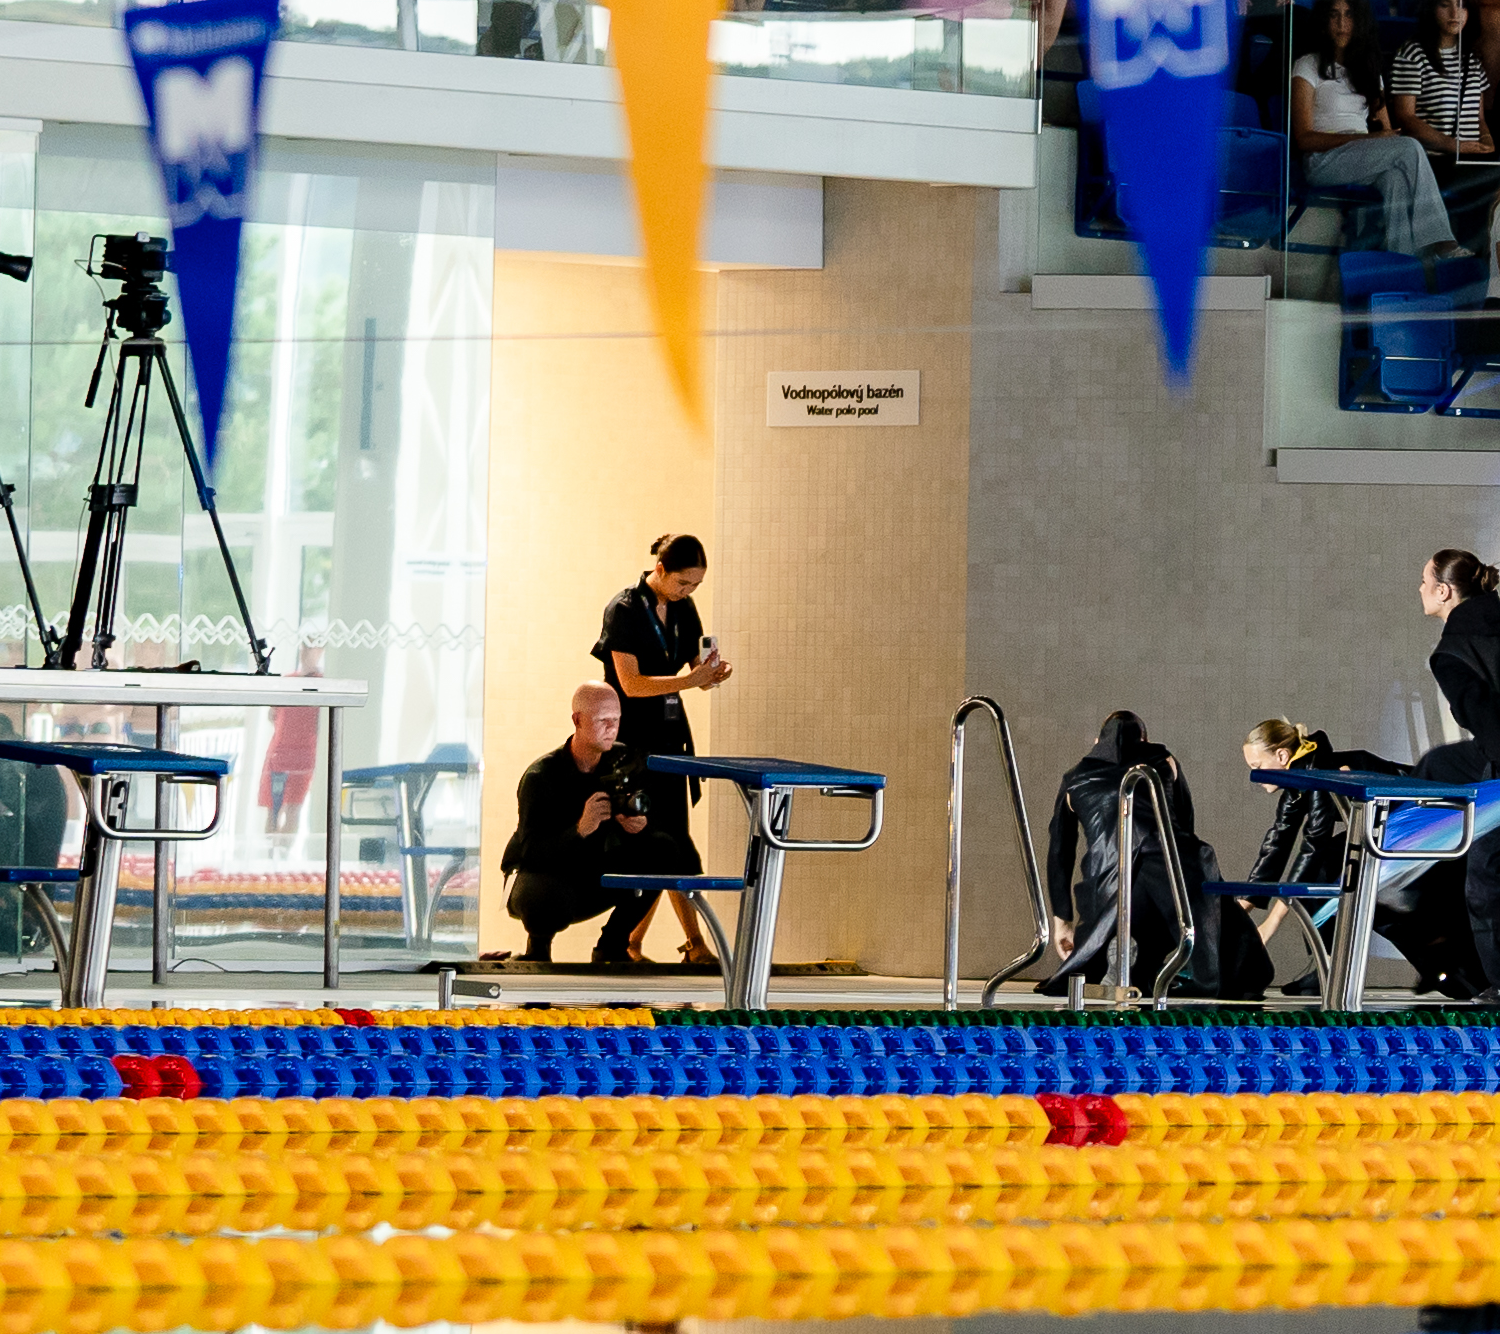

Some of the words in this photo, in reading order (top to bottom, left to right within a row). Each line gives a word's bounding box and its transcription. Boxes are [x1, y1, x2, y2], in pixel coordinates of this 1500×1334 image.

[781, 384, 864, 403] Vodnopólový
[866, 383, 904, 399] bazén
[806, 404, 834, 416] Water
[835, 404, 856, 418] polo
[857, 404, 880, 418] pool
